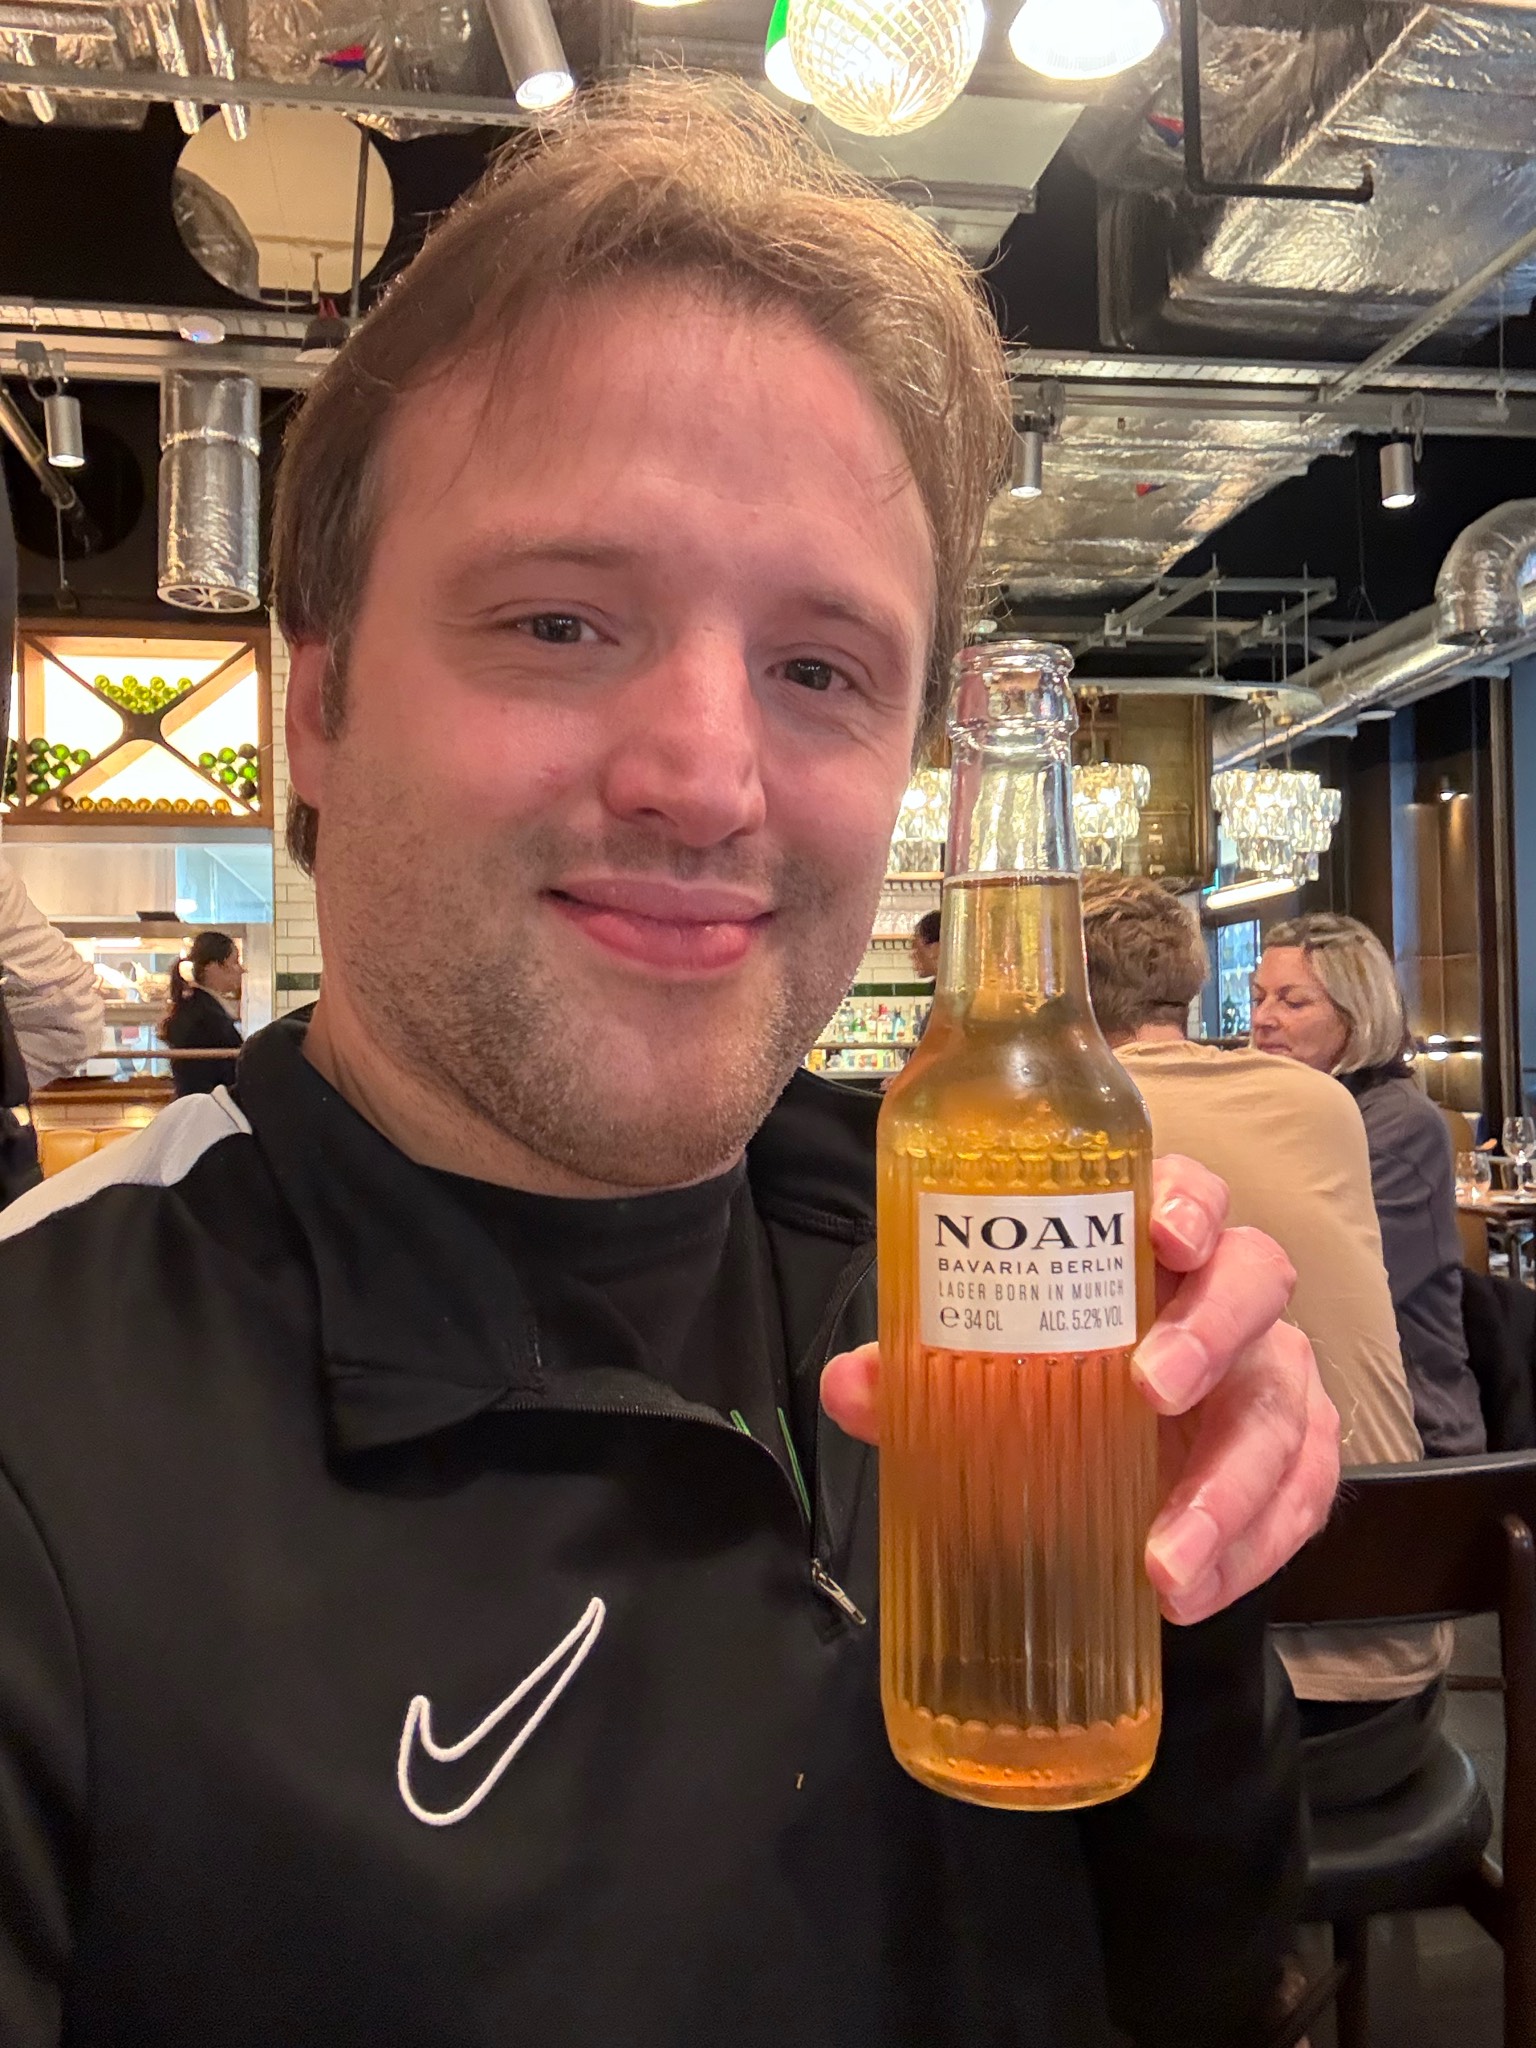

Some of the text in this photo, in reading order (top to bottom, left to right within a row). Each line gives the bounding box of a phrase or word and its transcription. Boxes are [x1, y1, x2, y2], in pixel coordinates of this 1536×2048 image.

[935, 1213, 1125, 1250] NOAM
[938, 1256, 1123, 1275] BAVARIA BERLIN
[938, 1279, 1124, 1301] LAGER BORN IN MUNICH
[1039, 1306, 1124, 1332] ALC. 5.2% VOL
